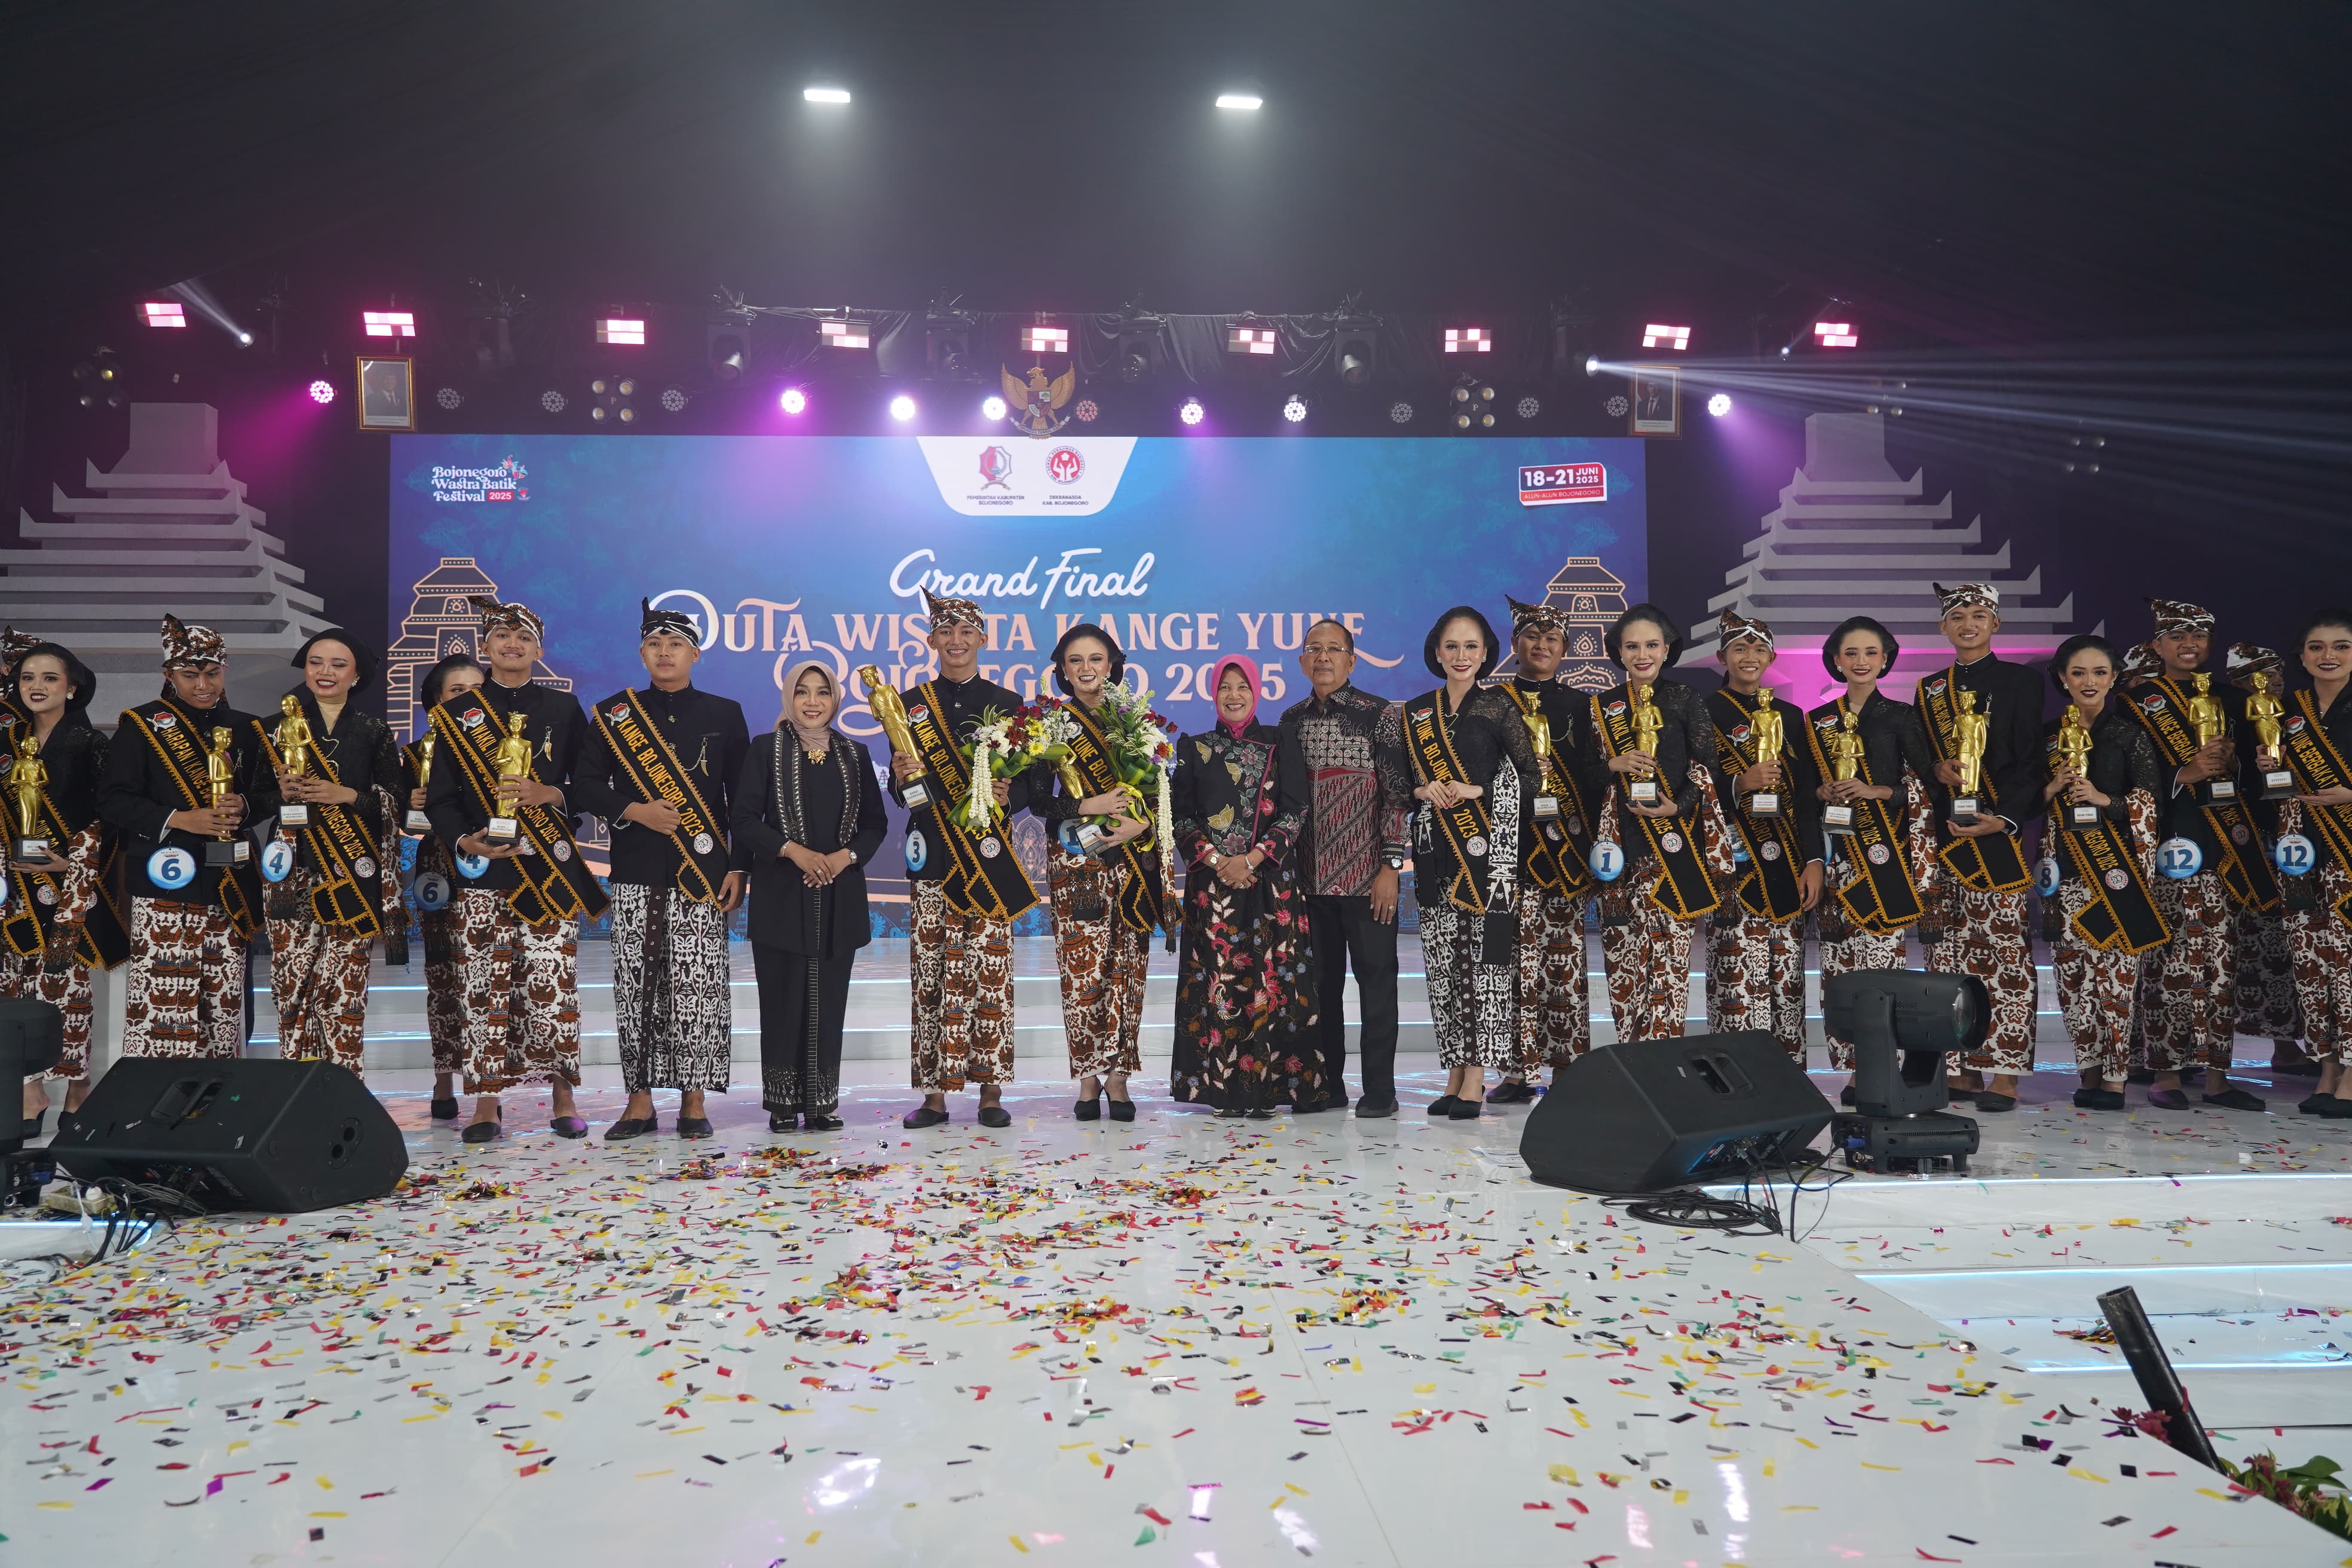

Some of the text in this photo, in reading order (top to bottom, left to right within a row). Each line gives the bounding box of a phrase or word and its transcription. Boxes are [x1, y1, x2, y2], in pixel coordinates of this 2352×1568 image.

[431, 477, 517, 489] Wastra Batik
[432, 466, 507, 482] Bojonegoro
[1525, 467, 1598, 487] 18-21 JUNI
[1576, 476, 1599, 484] 2025
[433, 490, 512, 502] Festival 2025
[889, 547, 1156, 615] Grand Final
[831, 613, 1036, 651] WISTA
[1165, 663, 1286, 702] 205
[470, 723, 497, 752] WAKIL
[1609, 713, 1631, 741] WAKIL
[2151, 708, 2198, 764] KANGE BERBAKA
[161, 725, 197, 762] HARAPAN
[1070, 734, 1099, 763] YUNE
[914, 719, 969, 804] KANGE BOJONEGO
[2289, 729, 2339, 788] YUNE BERBAKAT
[617, 718, 649, 753] KANGE
[637, 748, 687, 808] BOJONEGORO
[679, 807, 706, 837] 2023
[1416, 718, 1435, 745] YUNE
[1453, 808, 1479, 839] 2023
[317, 804, 356, 843] JONEGORO
[343, 839, 367, 860] 2025
[540, 823, 562, 844] 2025
[1861, 826, 1882, 846] 2025
[912, 840, 920, 863] 3
[1600, 852, 1612, 872] 1
[2096, 851, 2120, 871] 2025
[2164, 849, 2194, 870] 12
[2283, 845, 2308, 867] 12
[161, 858, 182, 881] 6
[269, 855, 283, 874] 4
[2040, 867, 2052, 888] 8
[422, 881, 439, 903] 6
